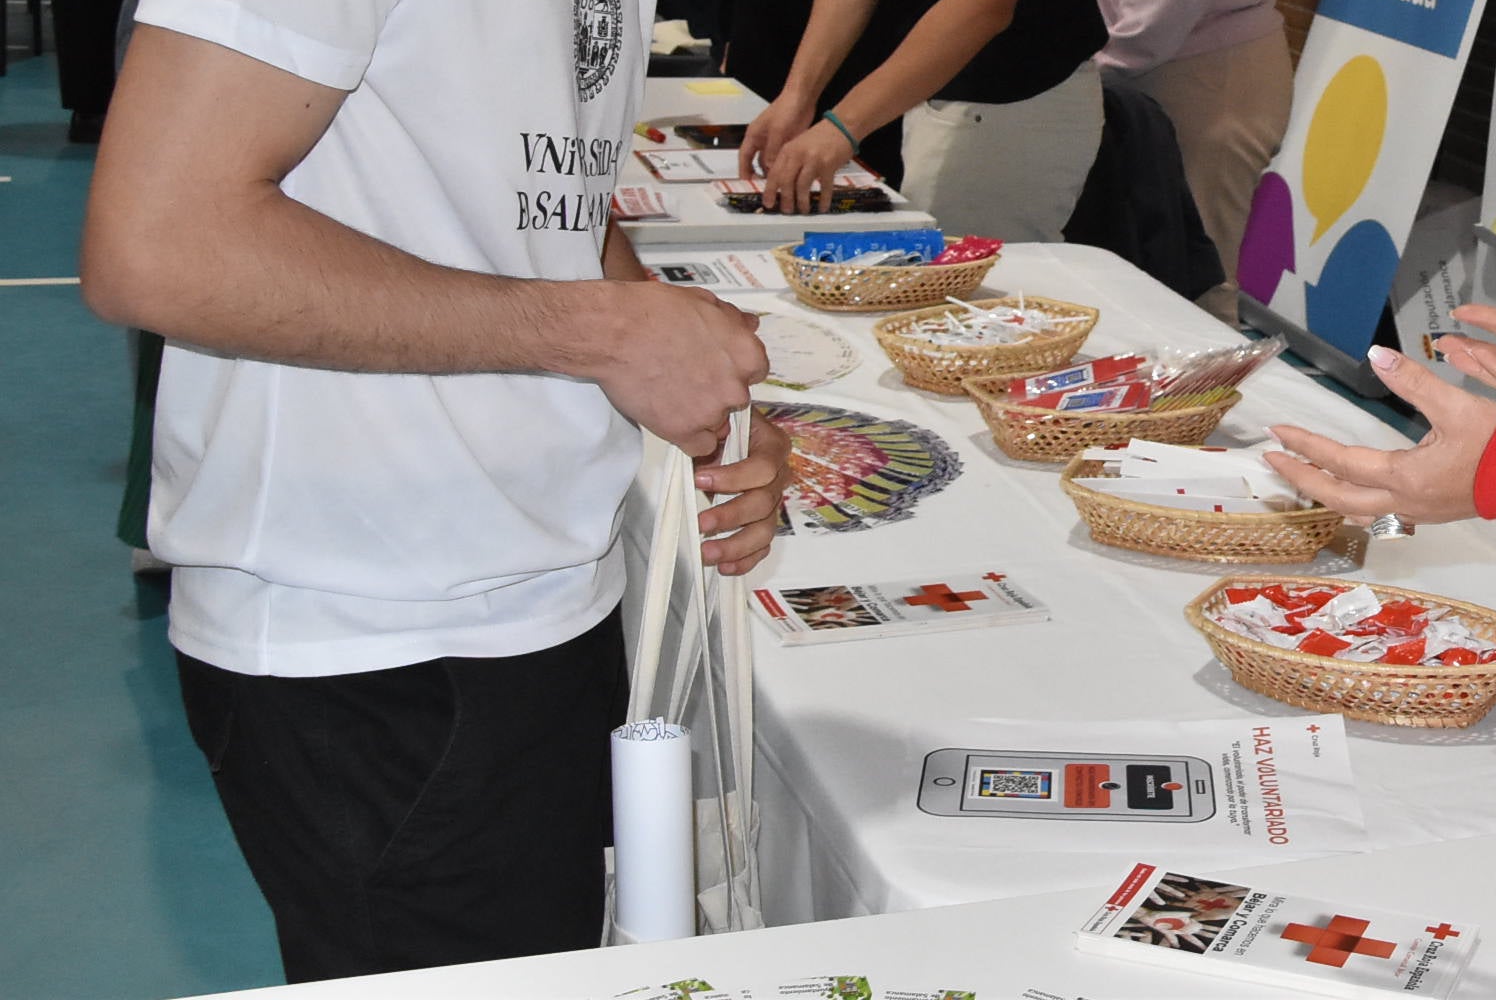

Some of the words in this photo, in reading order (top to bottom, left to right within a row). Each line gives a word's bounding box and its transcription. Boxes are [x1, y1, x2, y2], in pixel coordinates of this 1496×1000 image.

[1440, 260, 1457, 310] alamanca
[1420, 270, 1439, 330] Diputación
[1252, 727, 1273, 755] HAZ
[1256, 758, 1289, 845] VOLUNTARIADO
[1243, 893, 1267, 912] Béjar
[1269, 897, 1287, 908] Mira
[1257, 913, 1271, 924] que
[1212, 920, 1248, 952] Comarca
[1240, 924, 1265, 947] hacemos
[1426, 941, 1444, 955] Cruz
[1417, 954, 1437, 967] Roja
